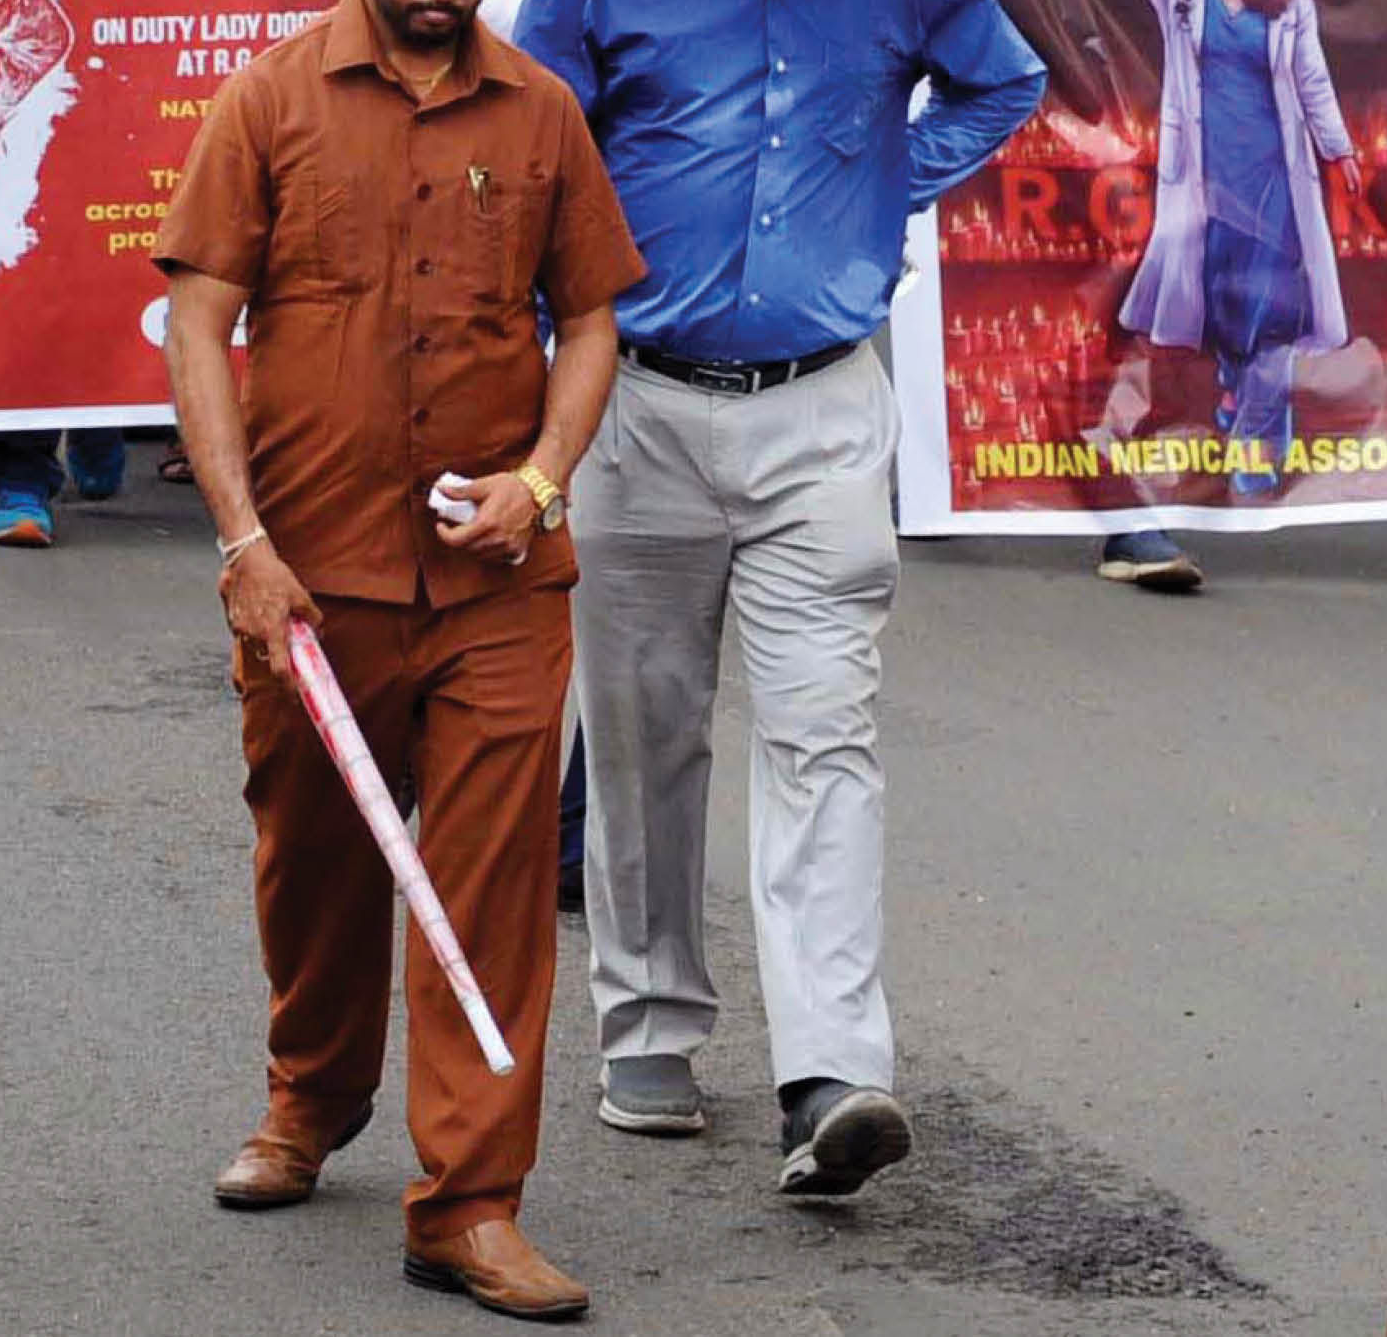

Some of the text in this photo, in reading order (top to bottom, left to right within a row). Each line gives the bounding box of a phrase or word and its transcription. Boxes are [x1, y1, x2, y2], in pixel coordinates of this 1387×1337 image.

[93, 17, 127, 46] ON
[132, 15, 195, 45] DUTY
[201, 13, 262, 41] LADY
[177, 49, 210, 77] AT
[975, 442, 1099, 478] INDIAN
[1111, 439, 1274, 475] MEDICAL
